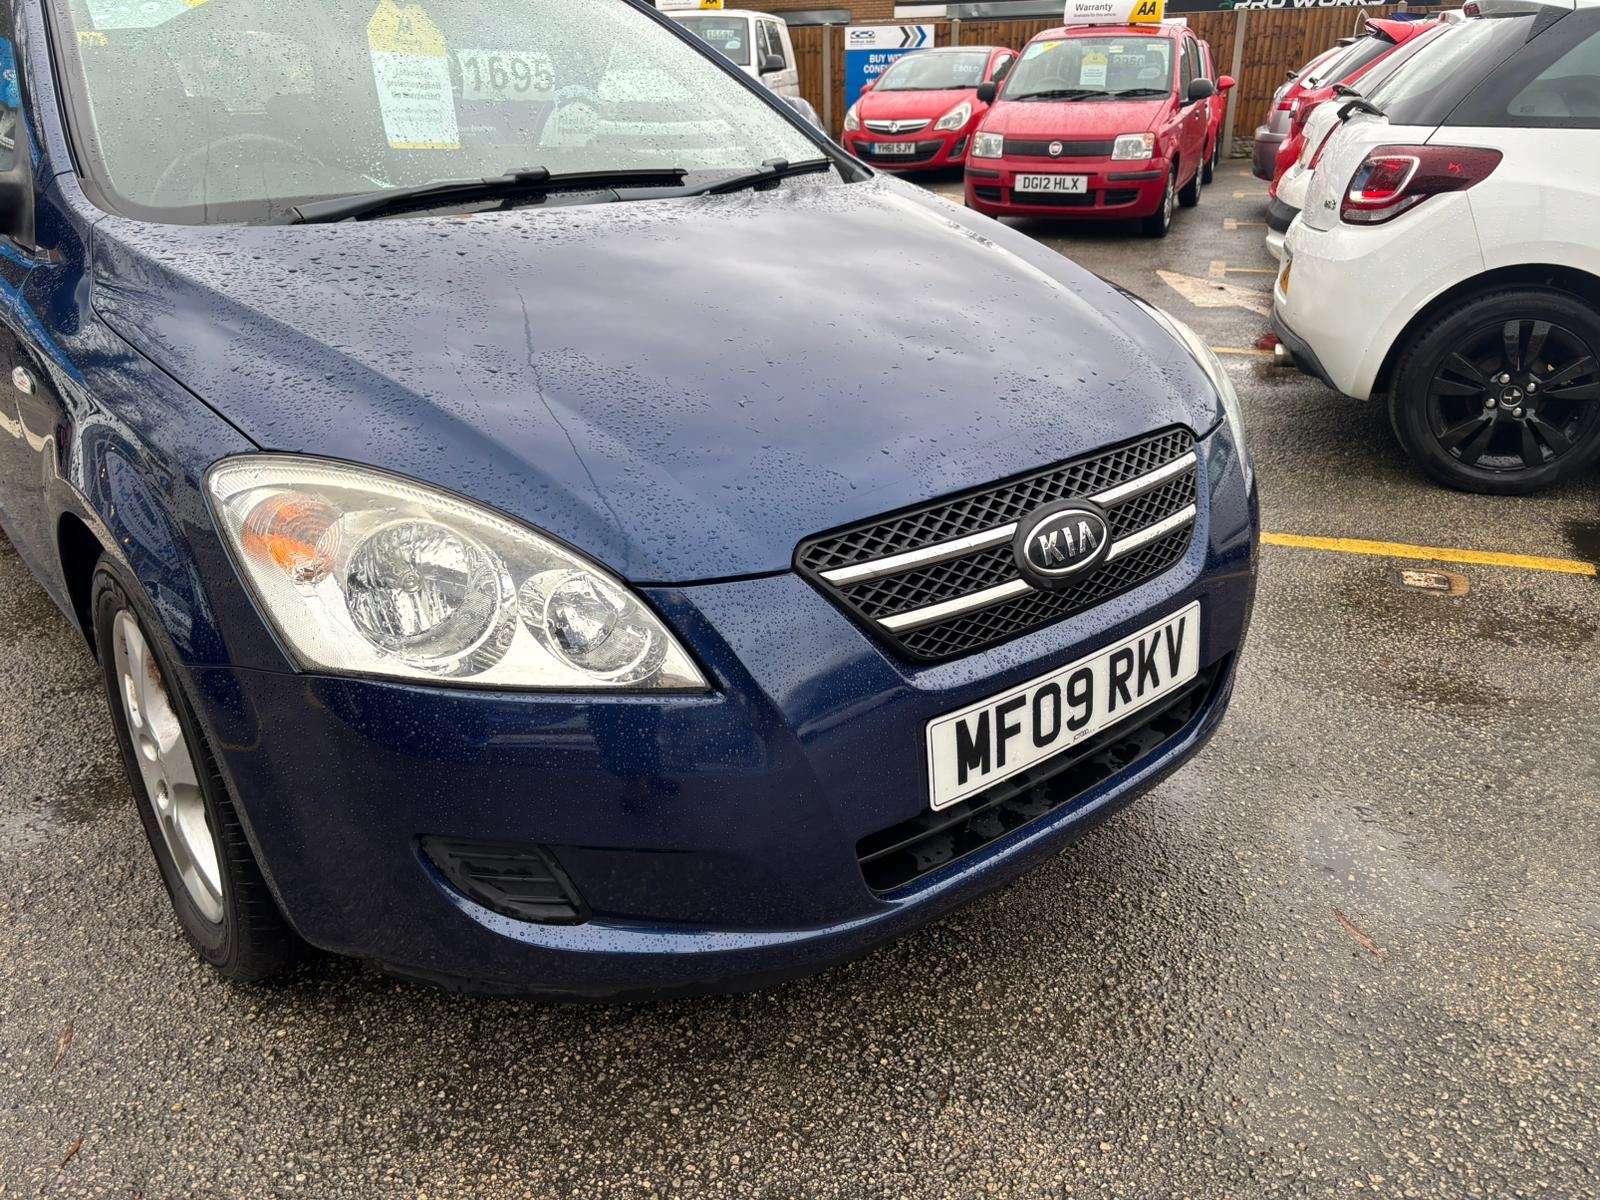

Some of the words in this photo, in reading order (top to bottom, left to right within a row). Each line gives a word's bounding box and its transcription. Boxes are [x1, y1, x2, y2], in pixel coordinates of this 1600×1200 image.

[1075, 3, 1113, 11] Warranty
[1137, 2, 1157, 15] AA
[869, 54, 886, 63] BUY
[464, 56, 554, 92] 1695
[895, 143, 912, 153] SJY
[1023, 176, 1051, 190] DG12
[1053, 177, 1080, 191] HLX
[1037, 520, 1098, 567] KIA
[954, 667, 1094, 786] MF09
[1107, 616, 1186, 714] RKV
